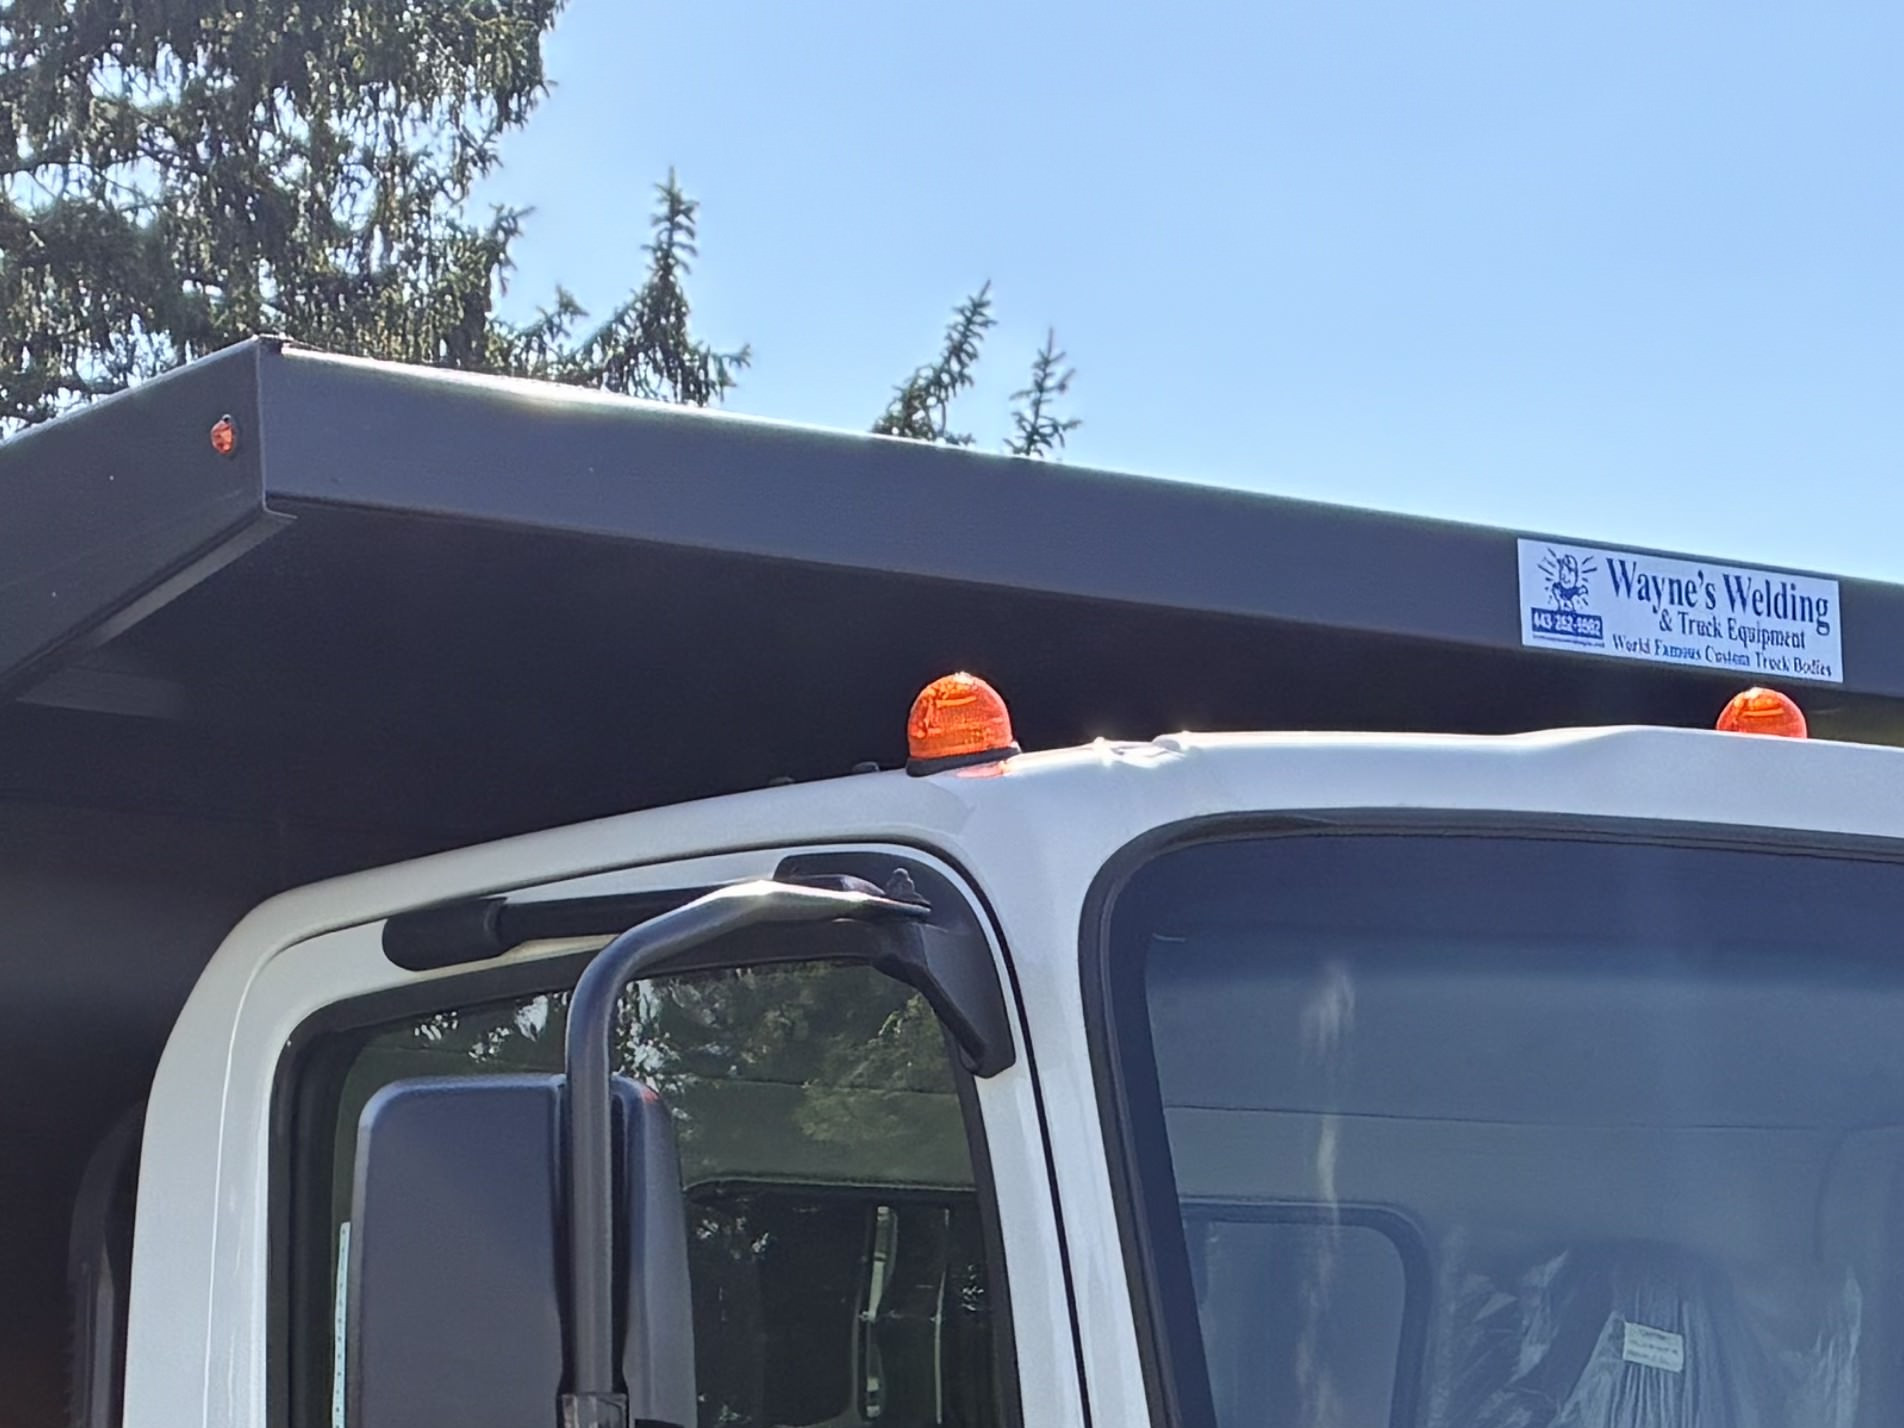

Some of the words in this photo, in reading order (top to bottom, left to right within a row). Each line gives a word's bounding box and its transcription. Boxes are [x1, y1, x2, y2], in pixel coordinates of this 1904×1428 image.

[1606, 558, 1716, 614] Wayne's
[1723, 573, 1831, 636] Welding
[1659, 608, 1673, 632] &
[1678, 611, 1723, 639] Truck
[1728, 617, 1805, 650] Equipment
[1613, 634, 1651, 654] World
[1655, 639, 1702, 660] Famous
[1705, 645, 1750, 666] Custom
[1756, 652, 1789, 672] Truck
[1794, 657, 1832, 677] Bodies
